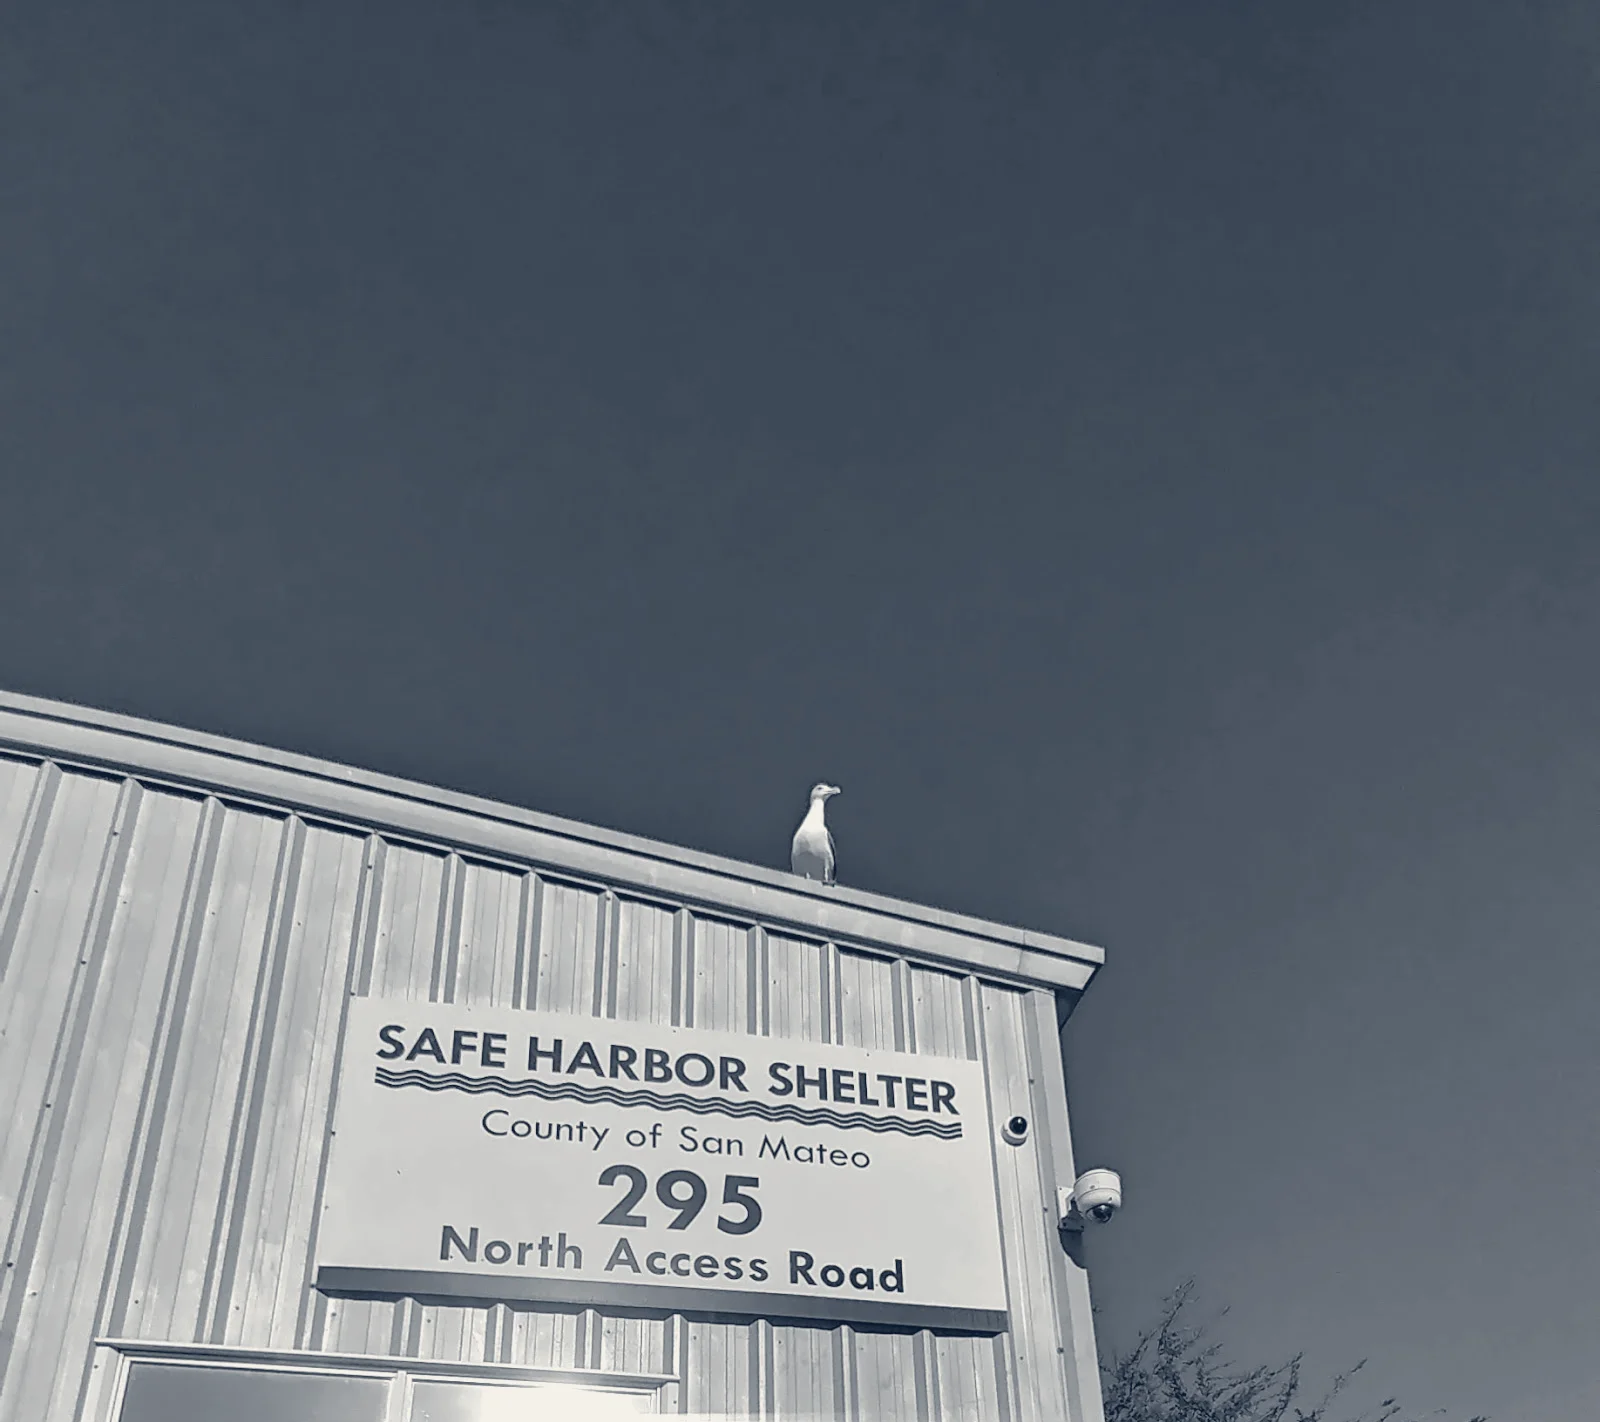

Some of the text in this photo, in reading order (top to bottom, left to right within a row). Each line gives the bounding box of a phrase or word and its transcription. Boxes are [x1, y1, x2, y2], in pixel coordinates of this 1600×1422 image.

[375, 1024, 960, 1116] SAFE HARBOR SHELTER
[481, 1109, 871, 1169] County of San Mateo
[597, 1164, 763, 1236] 295
[439, 1225, 905, 1294] North Access Road
